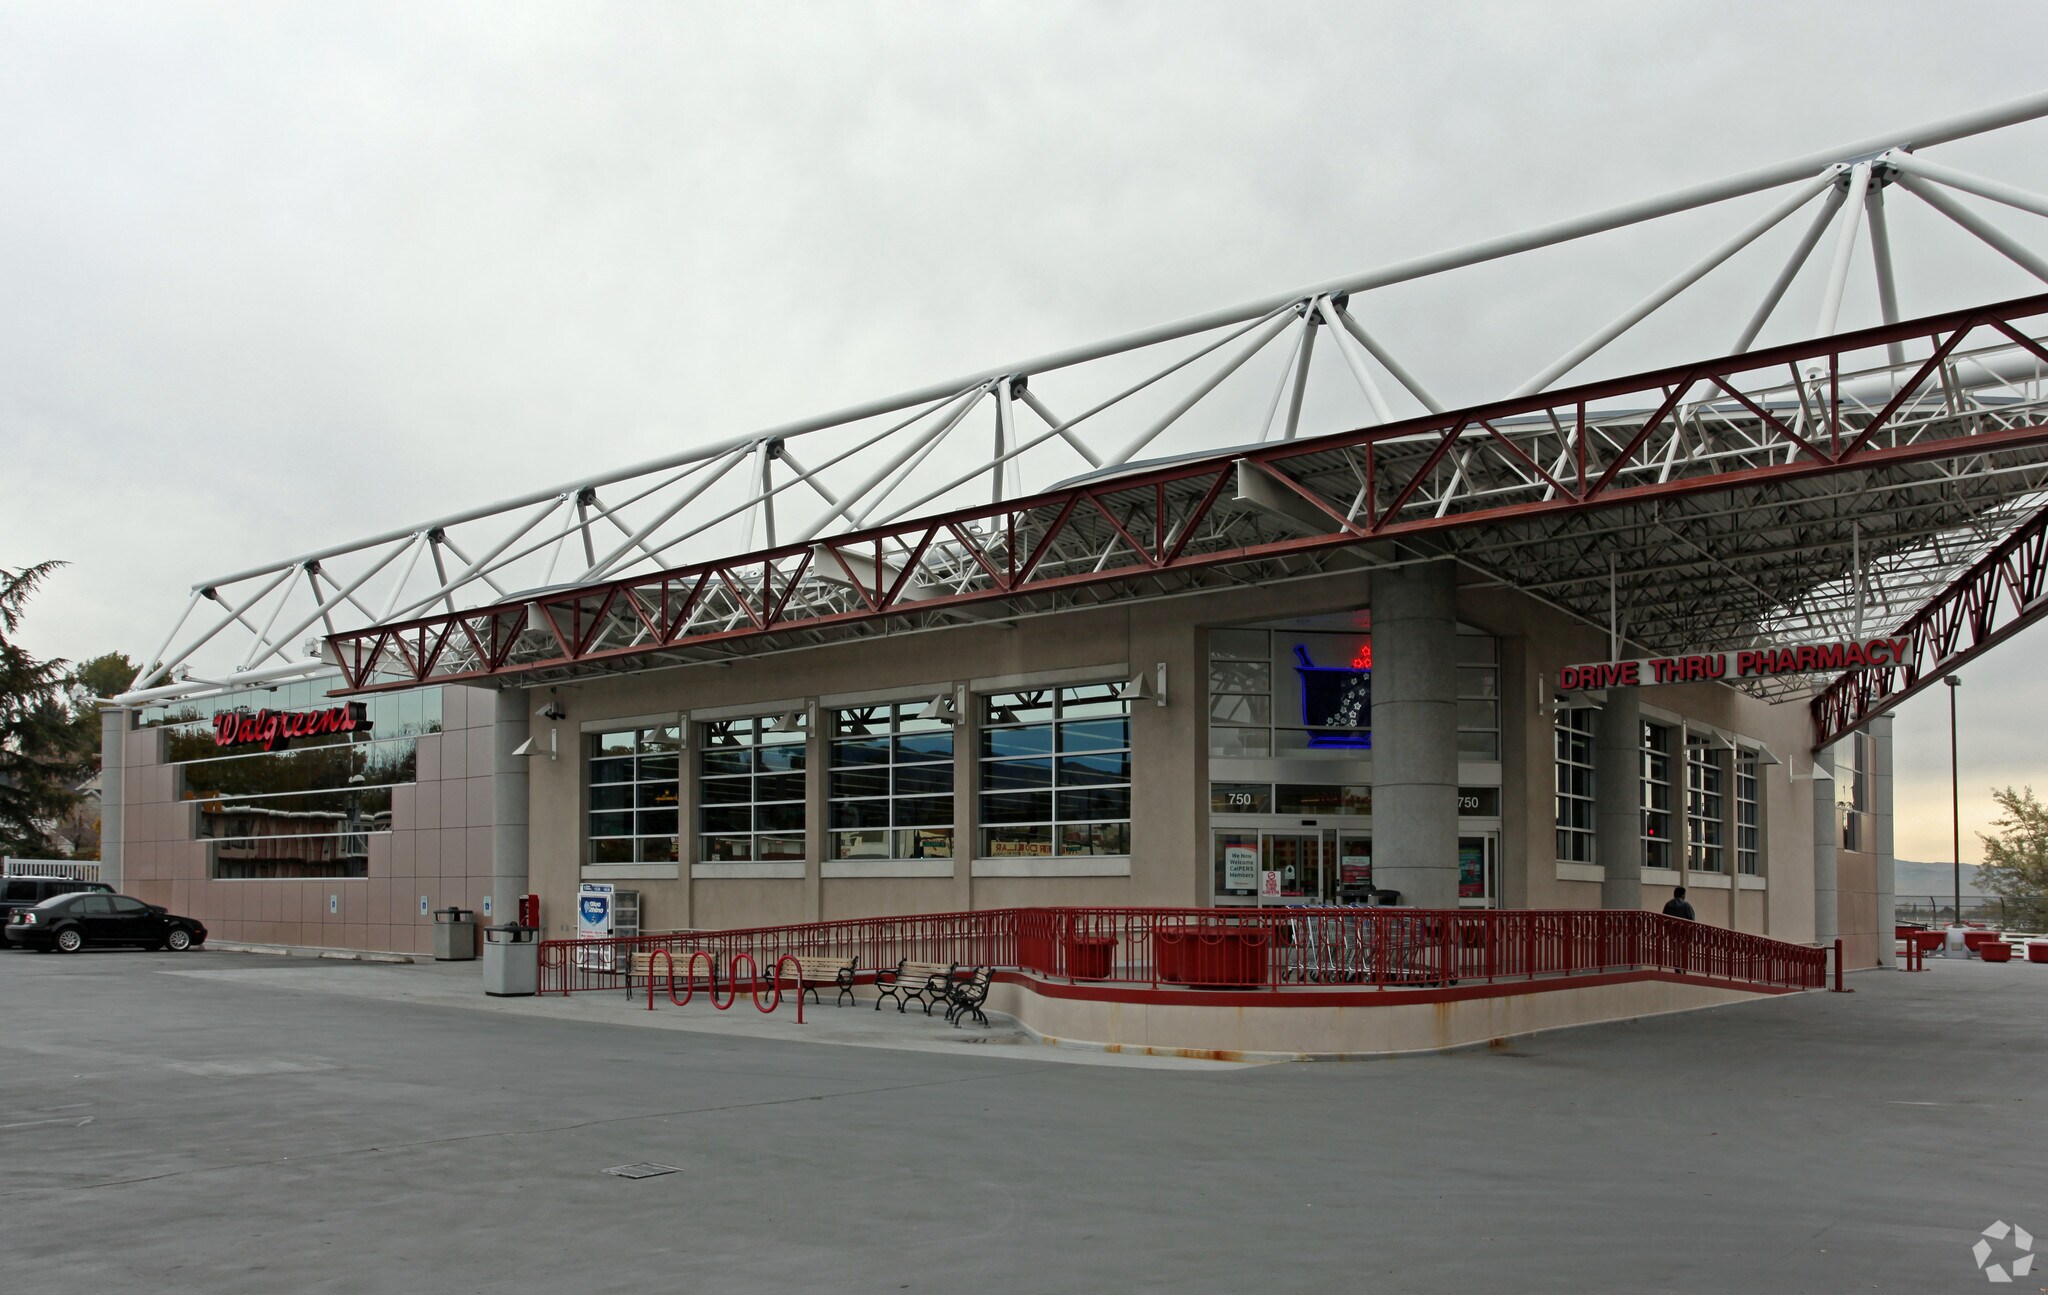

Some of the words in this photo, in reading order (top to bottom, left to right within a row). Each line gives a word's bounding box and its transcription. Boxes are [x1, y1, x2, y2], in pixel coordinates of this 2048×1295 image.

[1560, 661, 1639, 689] DRIVE
[1649, 653, 1726, 682] THRU
[1737, 637, 1910, 675] PHARMACY
[213, 701, 360, 751] Walgreens
[1228, 793, 1251, 805] 750
[1458, 797, 1479, 808] 750
